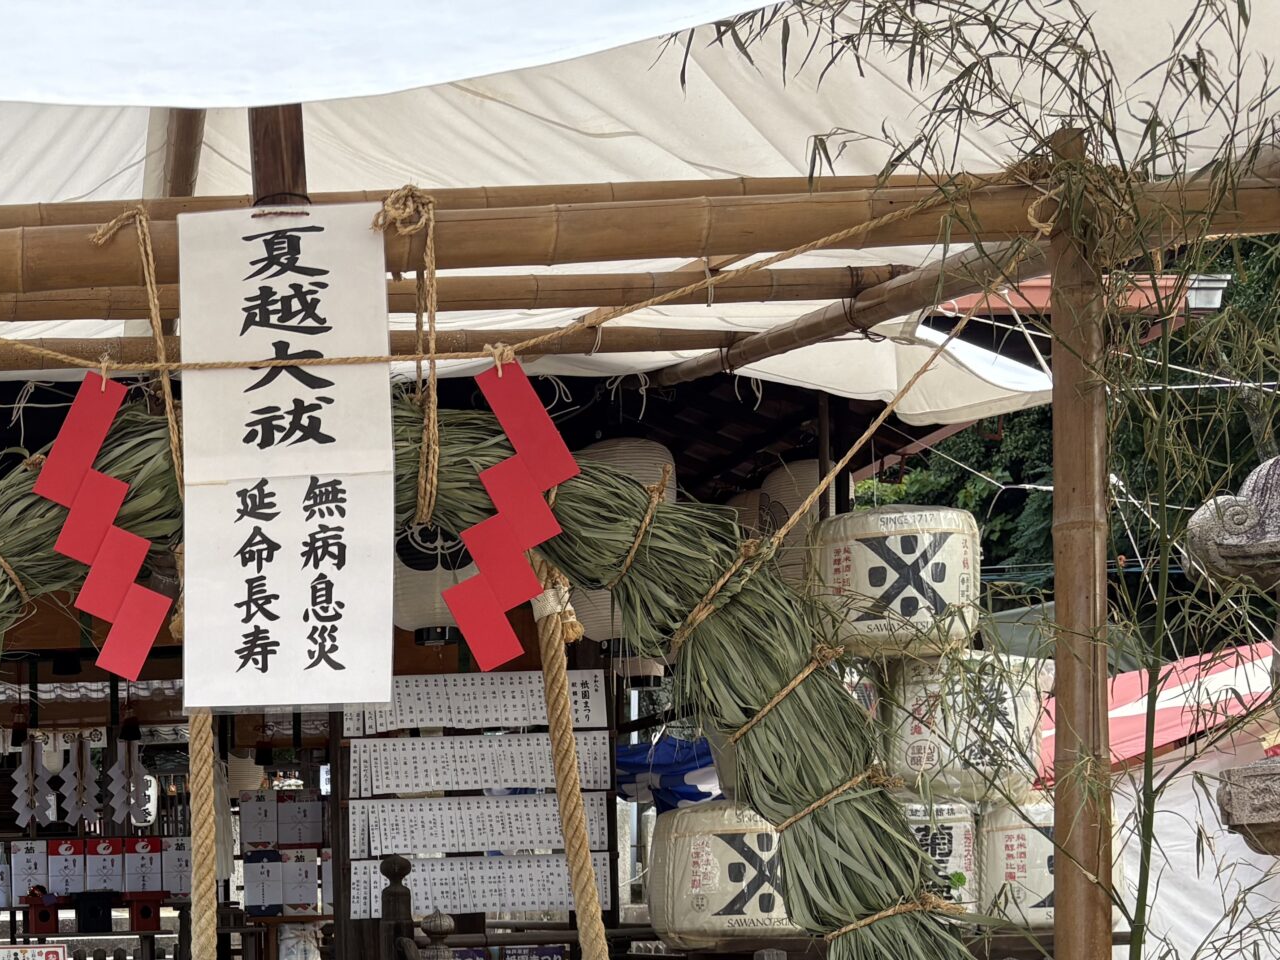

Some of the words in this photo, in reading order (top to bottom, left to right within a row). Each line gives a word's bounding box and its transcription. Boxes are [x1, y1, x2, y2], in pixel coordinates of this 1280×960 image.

[239, 225, 337, 451] 夏越大祓
[233, 477, 282, 675] 延命長寿
[300, 475, 348, 673] 無病息災
[580, 679, 591, 722] 祇園まつり
